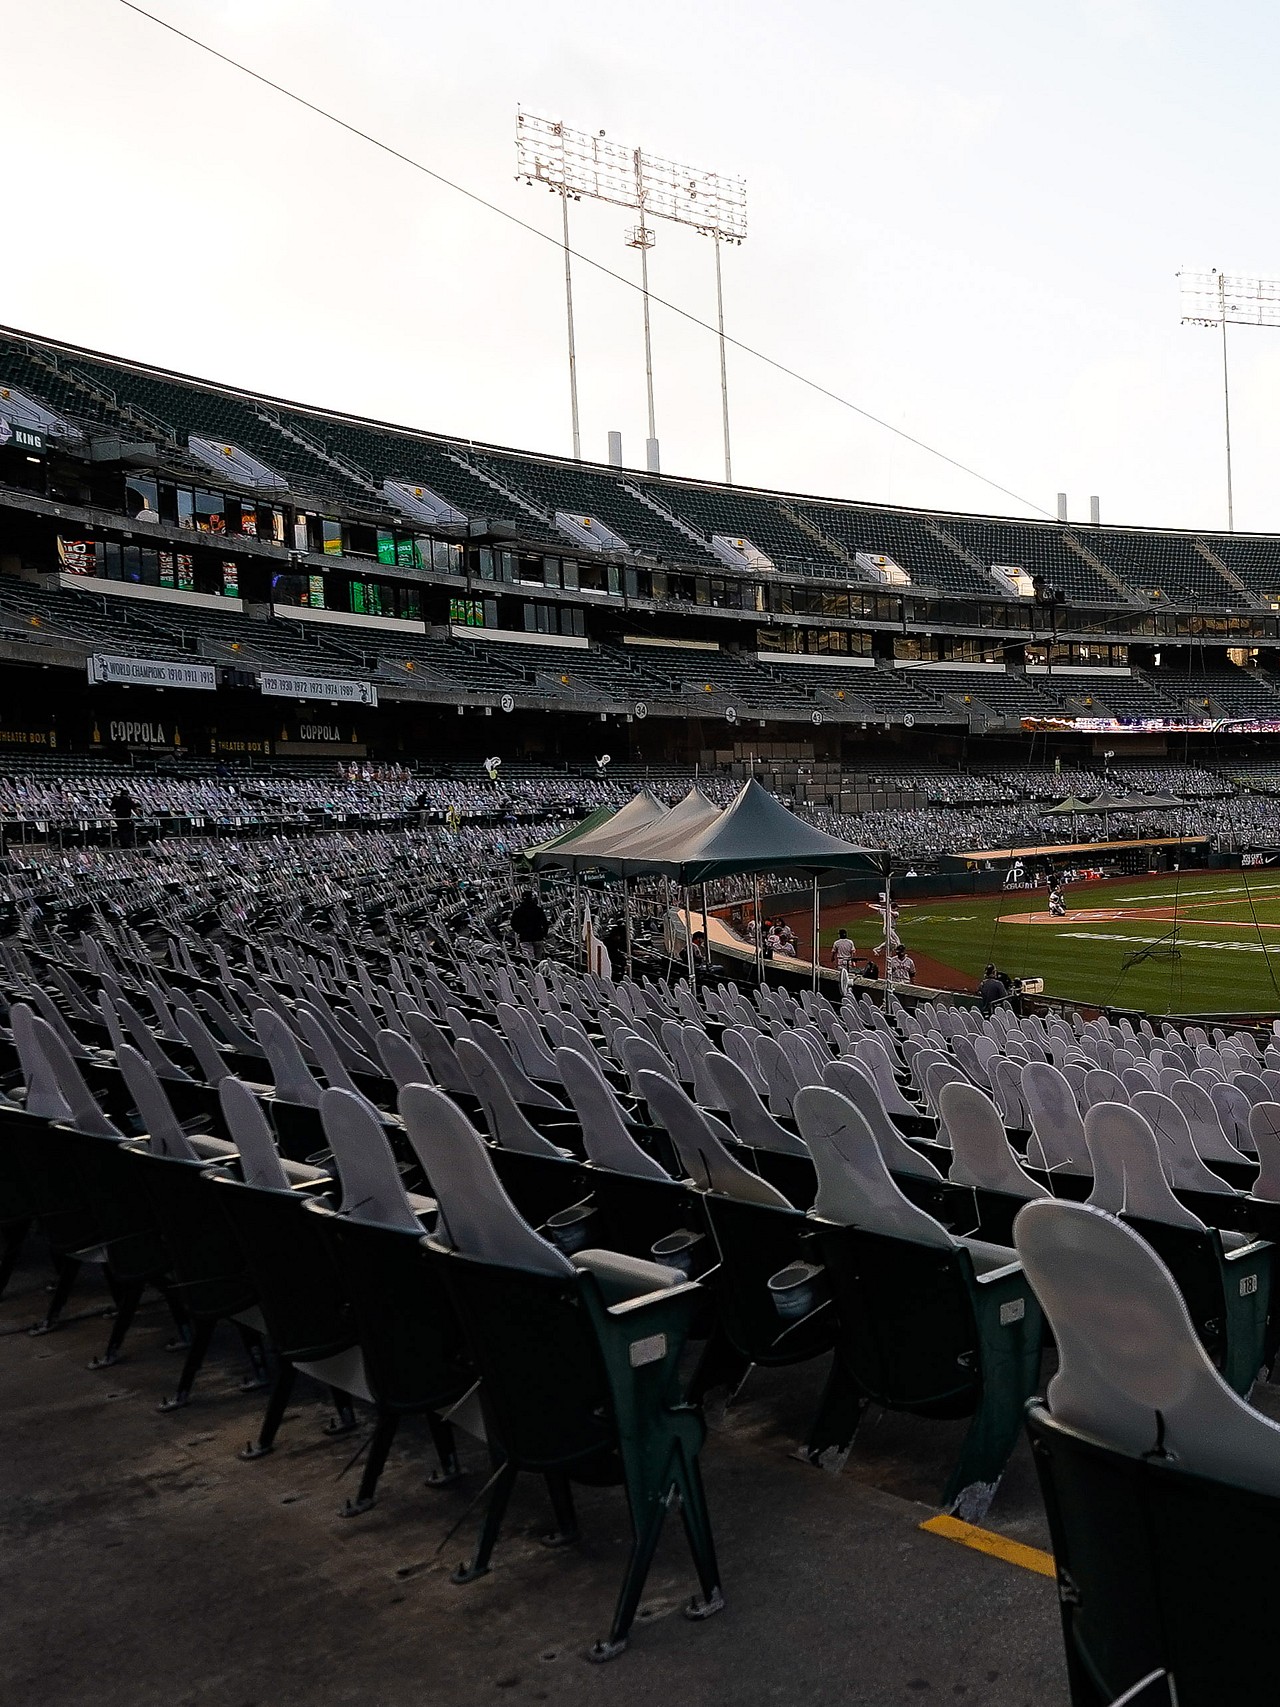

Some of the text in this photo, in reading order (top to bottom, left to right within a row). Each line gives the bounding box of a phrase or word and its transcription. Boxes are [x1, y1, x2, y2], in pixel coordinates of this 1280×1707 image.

[16, 430, 42, 448] KING
[110, 662, 214, 683] WORLD CHAMPIONS 1910 1911 1913
[295, 681, 308, 693] 1972
[309, 682, 322, 694] 1973
[325, 683, 338, 694] 1974
[29, 733, 47, 744] BOX
[110, 721, 166, 743] COPPOLA
[300, 724, 340, 741] COPPOLA
[218, 741, 262, 752] THEATER BOX
[1244, 1277, 1254, 1294] 18
